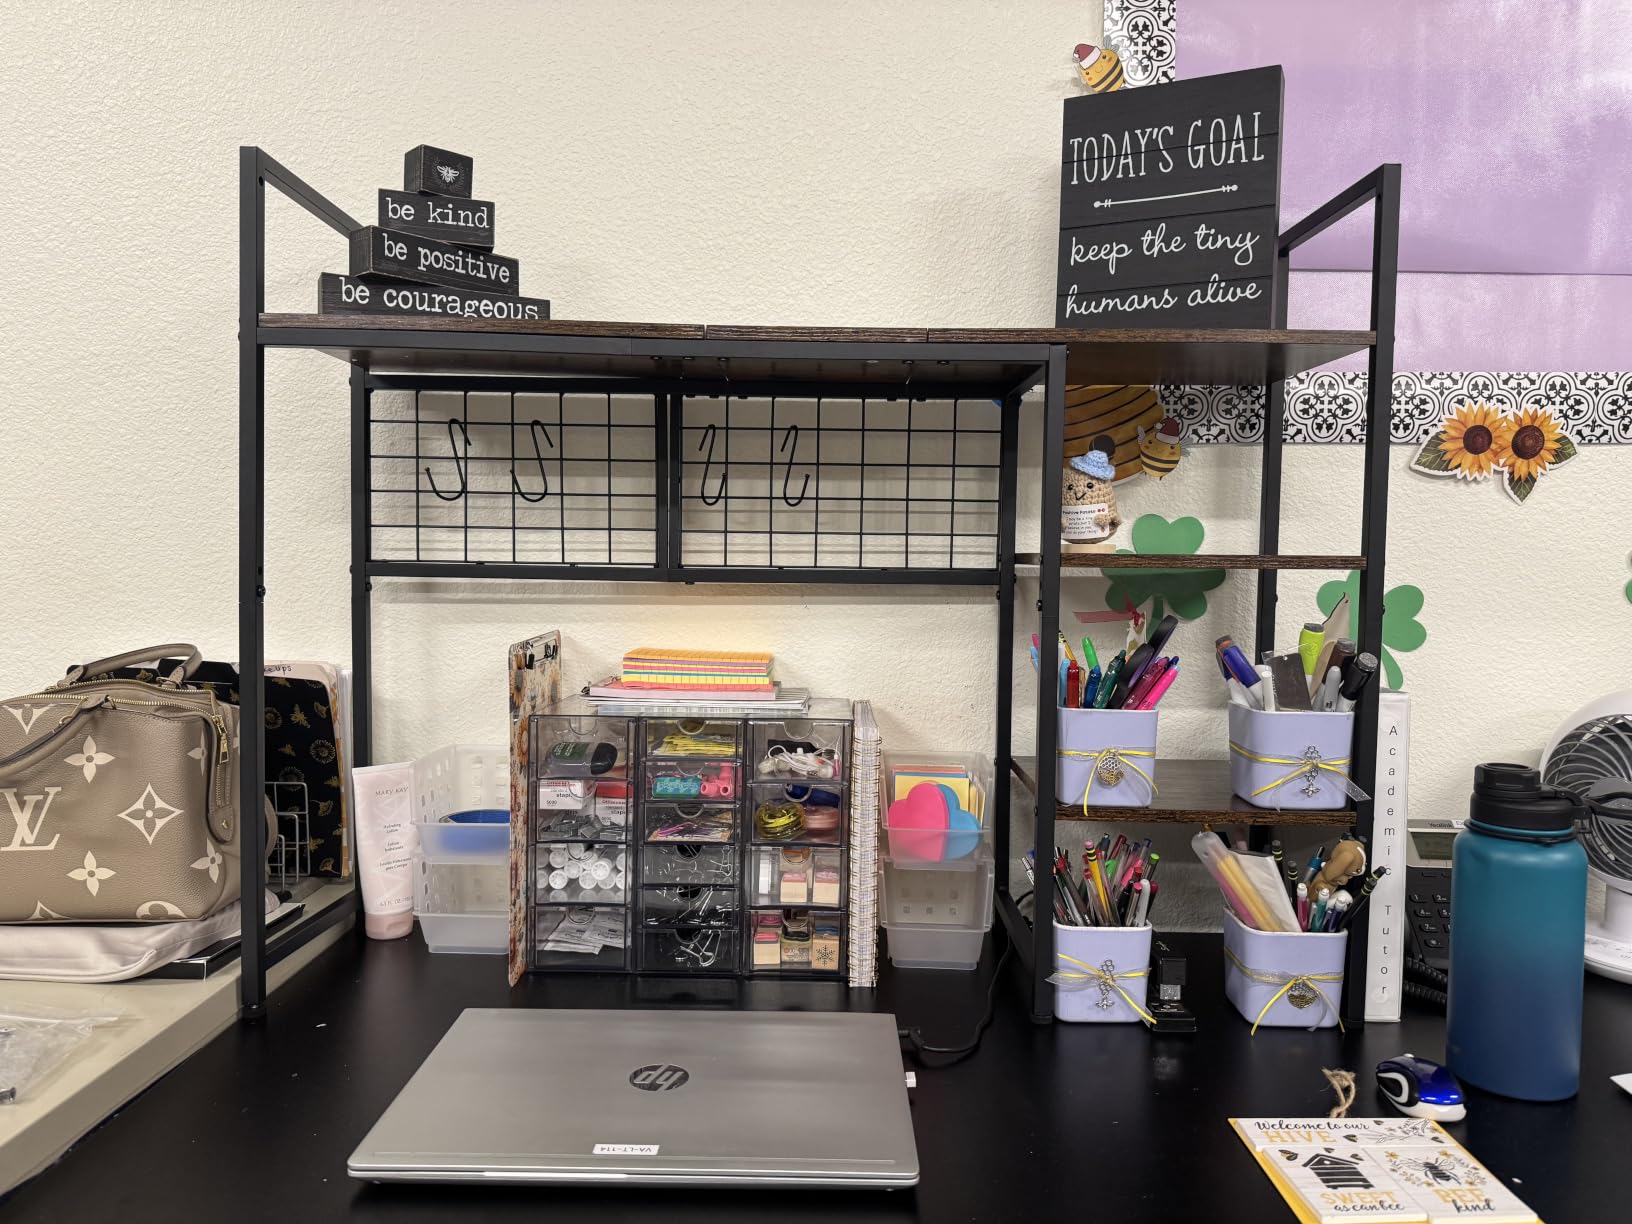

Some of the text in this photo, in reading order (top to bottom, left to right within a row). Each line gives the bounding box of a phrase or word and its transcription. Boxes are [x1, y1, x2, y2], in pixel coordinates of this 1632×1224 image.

[1069, 111, 1265, 185] TODAY'S GOAL
[385, 197, 490, 229] be kind
[382, 233, 510, 284] be positive
[1070, 222, 1260, 275] keep the tiny
[339, 277, 539, 320] be courageous
[1065, 273, 1262, 319] humans alive
[1380, 725, 1398, 994] Academic Tutor
[629, 1064, 690, 1092] hp
[1254, 1120, 1326, 1130] Welcome
[1327, 1121, 1341, 1130] to
[1261, 1130, 1337, 1143] HIVE
[600, 1145, 652, 1153] VA-LT-114
[1320, 1190, 1397, 1205] SWEET
[1333, 1200, 1405, 1212] as can bee
[1434, 1188, 1491, 1204] BEE
[1451, 1198, 1497, 1213] kind
